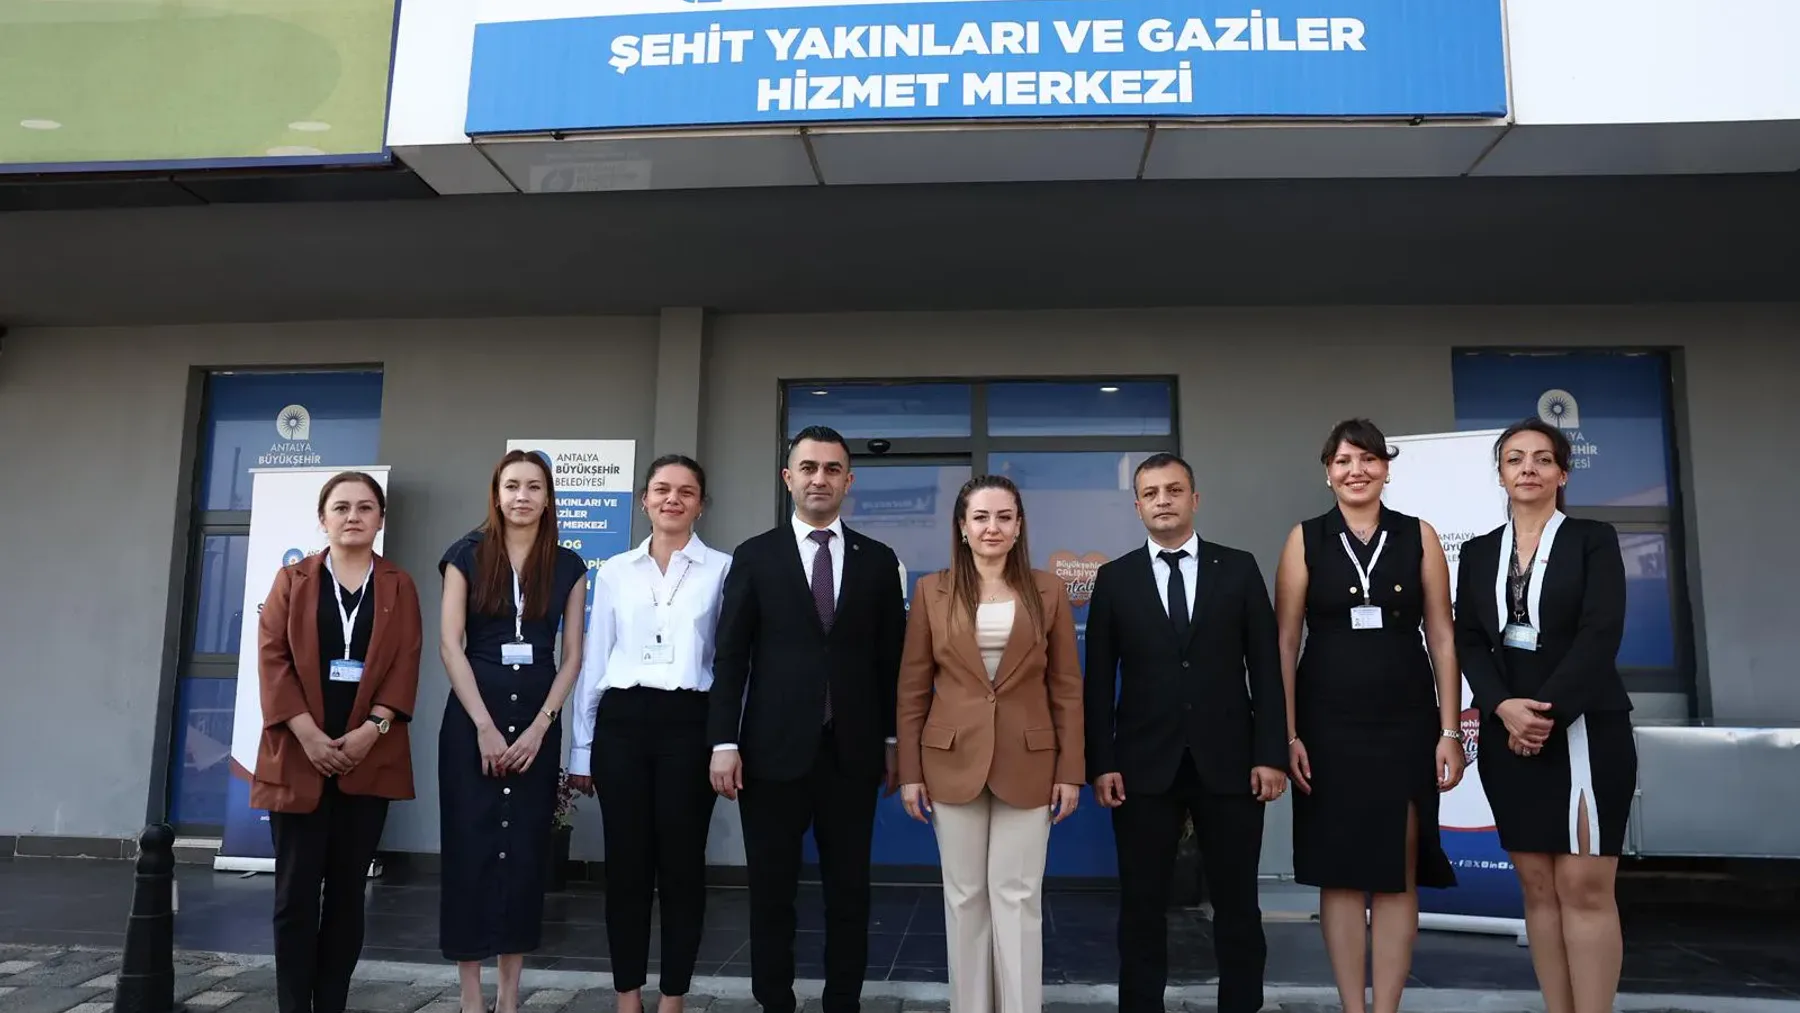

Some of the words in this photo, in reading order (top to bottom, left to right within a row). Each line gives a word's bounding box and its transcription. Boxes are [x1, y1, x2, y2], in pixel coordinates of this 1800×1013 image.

[609, 23, 754, 74] ŞEHİT
[765, 21, 1040, 61] YAKINLARI
[1053, 19, 1124, 53] VE
[1137, 9, 1366, 52] GAZİLER
[757, 69, 949, 111] HİZMET
[963, 61, 1193, 106] MERKEZİ
[270, 442, 312, 452] ANTALYA
[258, 452, 321, 466] BÜYÜKŞEHİR
[556, 453, 599, 462] ANTALYA
[555, 463, 620, 476] BÜYÜKŞEHİR
[554, 477, 606, 487] BELEDİYESİ
[555, 498, 601, 507] AKINLARI
[603, 498, 618, 507] VE
[562, 519, 608, 529] MERKEZİ
